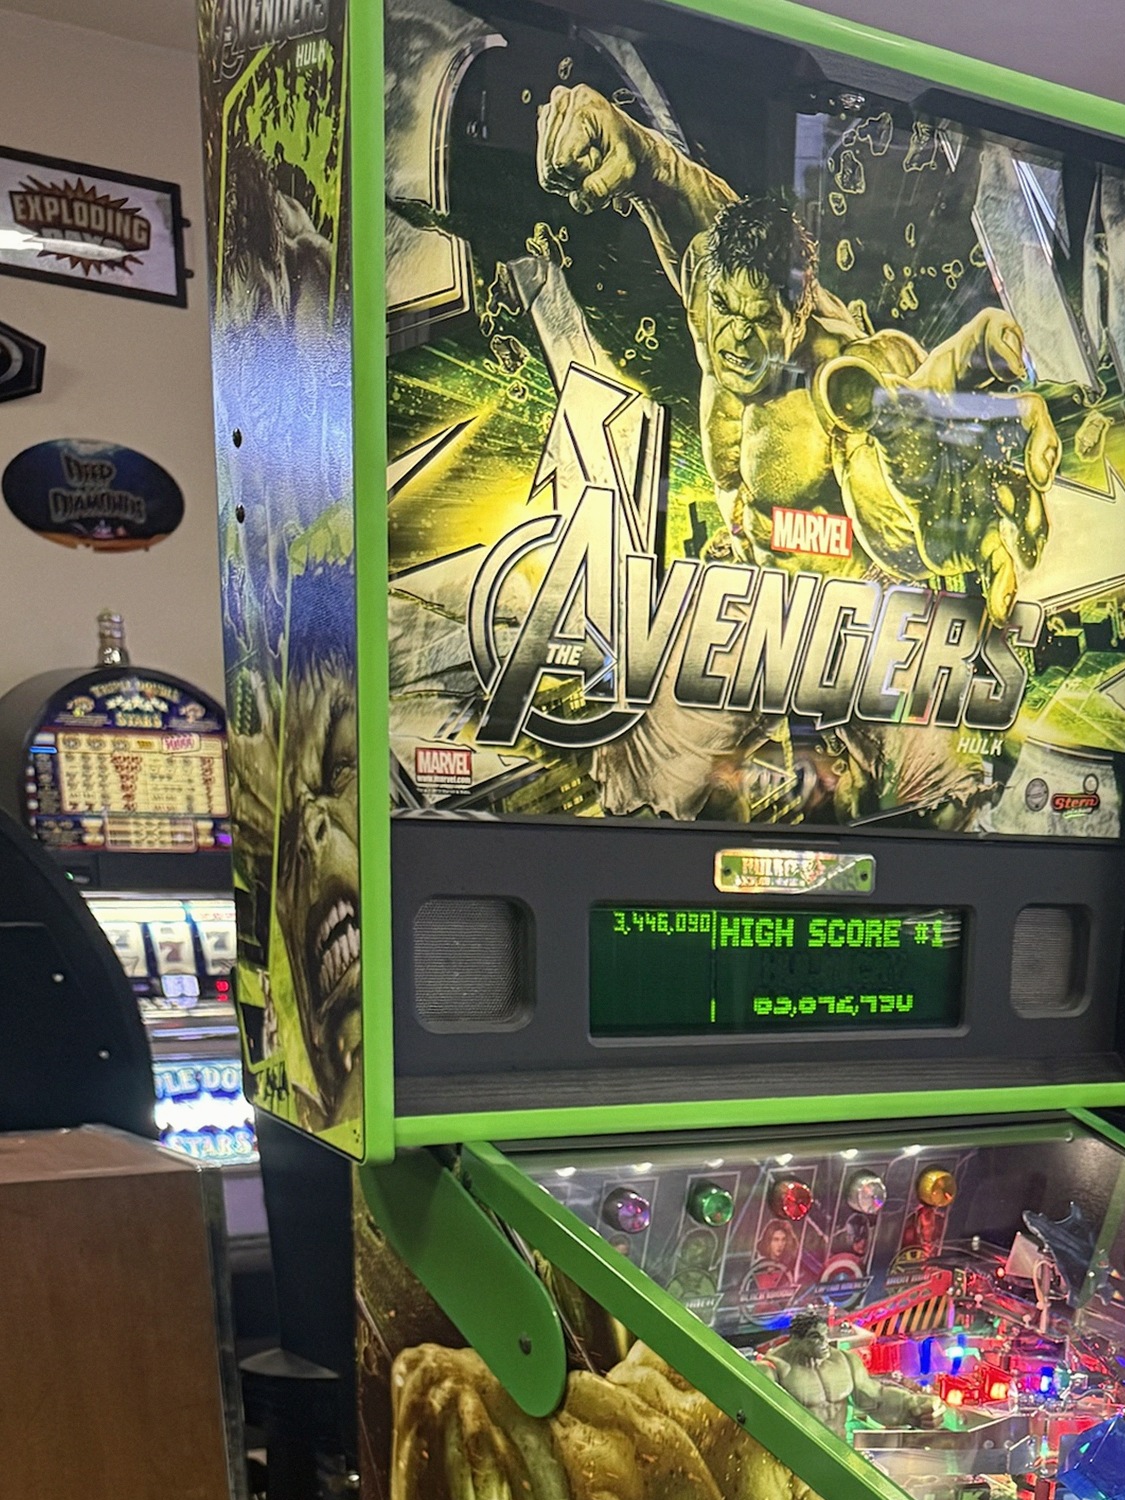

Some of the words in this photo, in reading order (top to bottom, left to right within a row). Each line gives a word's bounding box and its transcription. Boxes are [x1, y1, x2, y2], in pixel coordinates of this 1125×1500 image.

[11, 193, 149, 246] EXPLODING
[773, 511, 851, 556] MARVEL
[467, 487, 1044, 750] AVENGERS
[546, 641, 582, 667] THE
[956, 737, 1004, 757] HULK
[417, 750, 471, 775] MARVEL
[1053, 797, 1096, 811] Stern
[720, 917, 795, 947] HIGH
[808, 919, 901, 948] SCORE
[914, 920, 943, 948] #1
[171, 1132, 251, 1157] STARS
